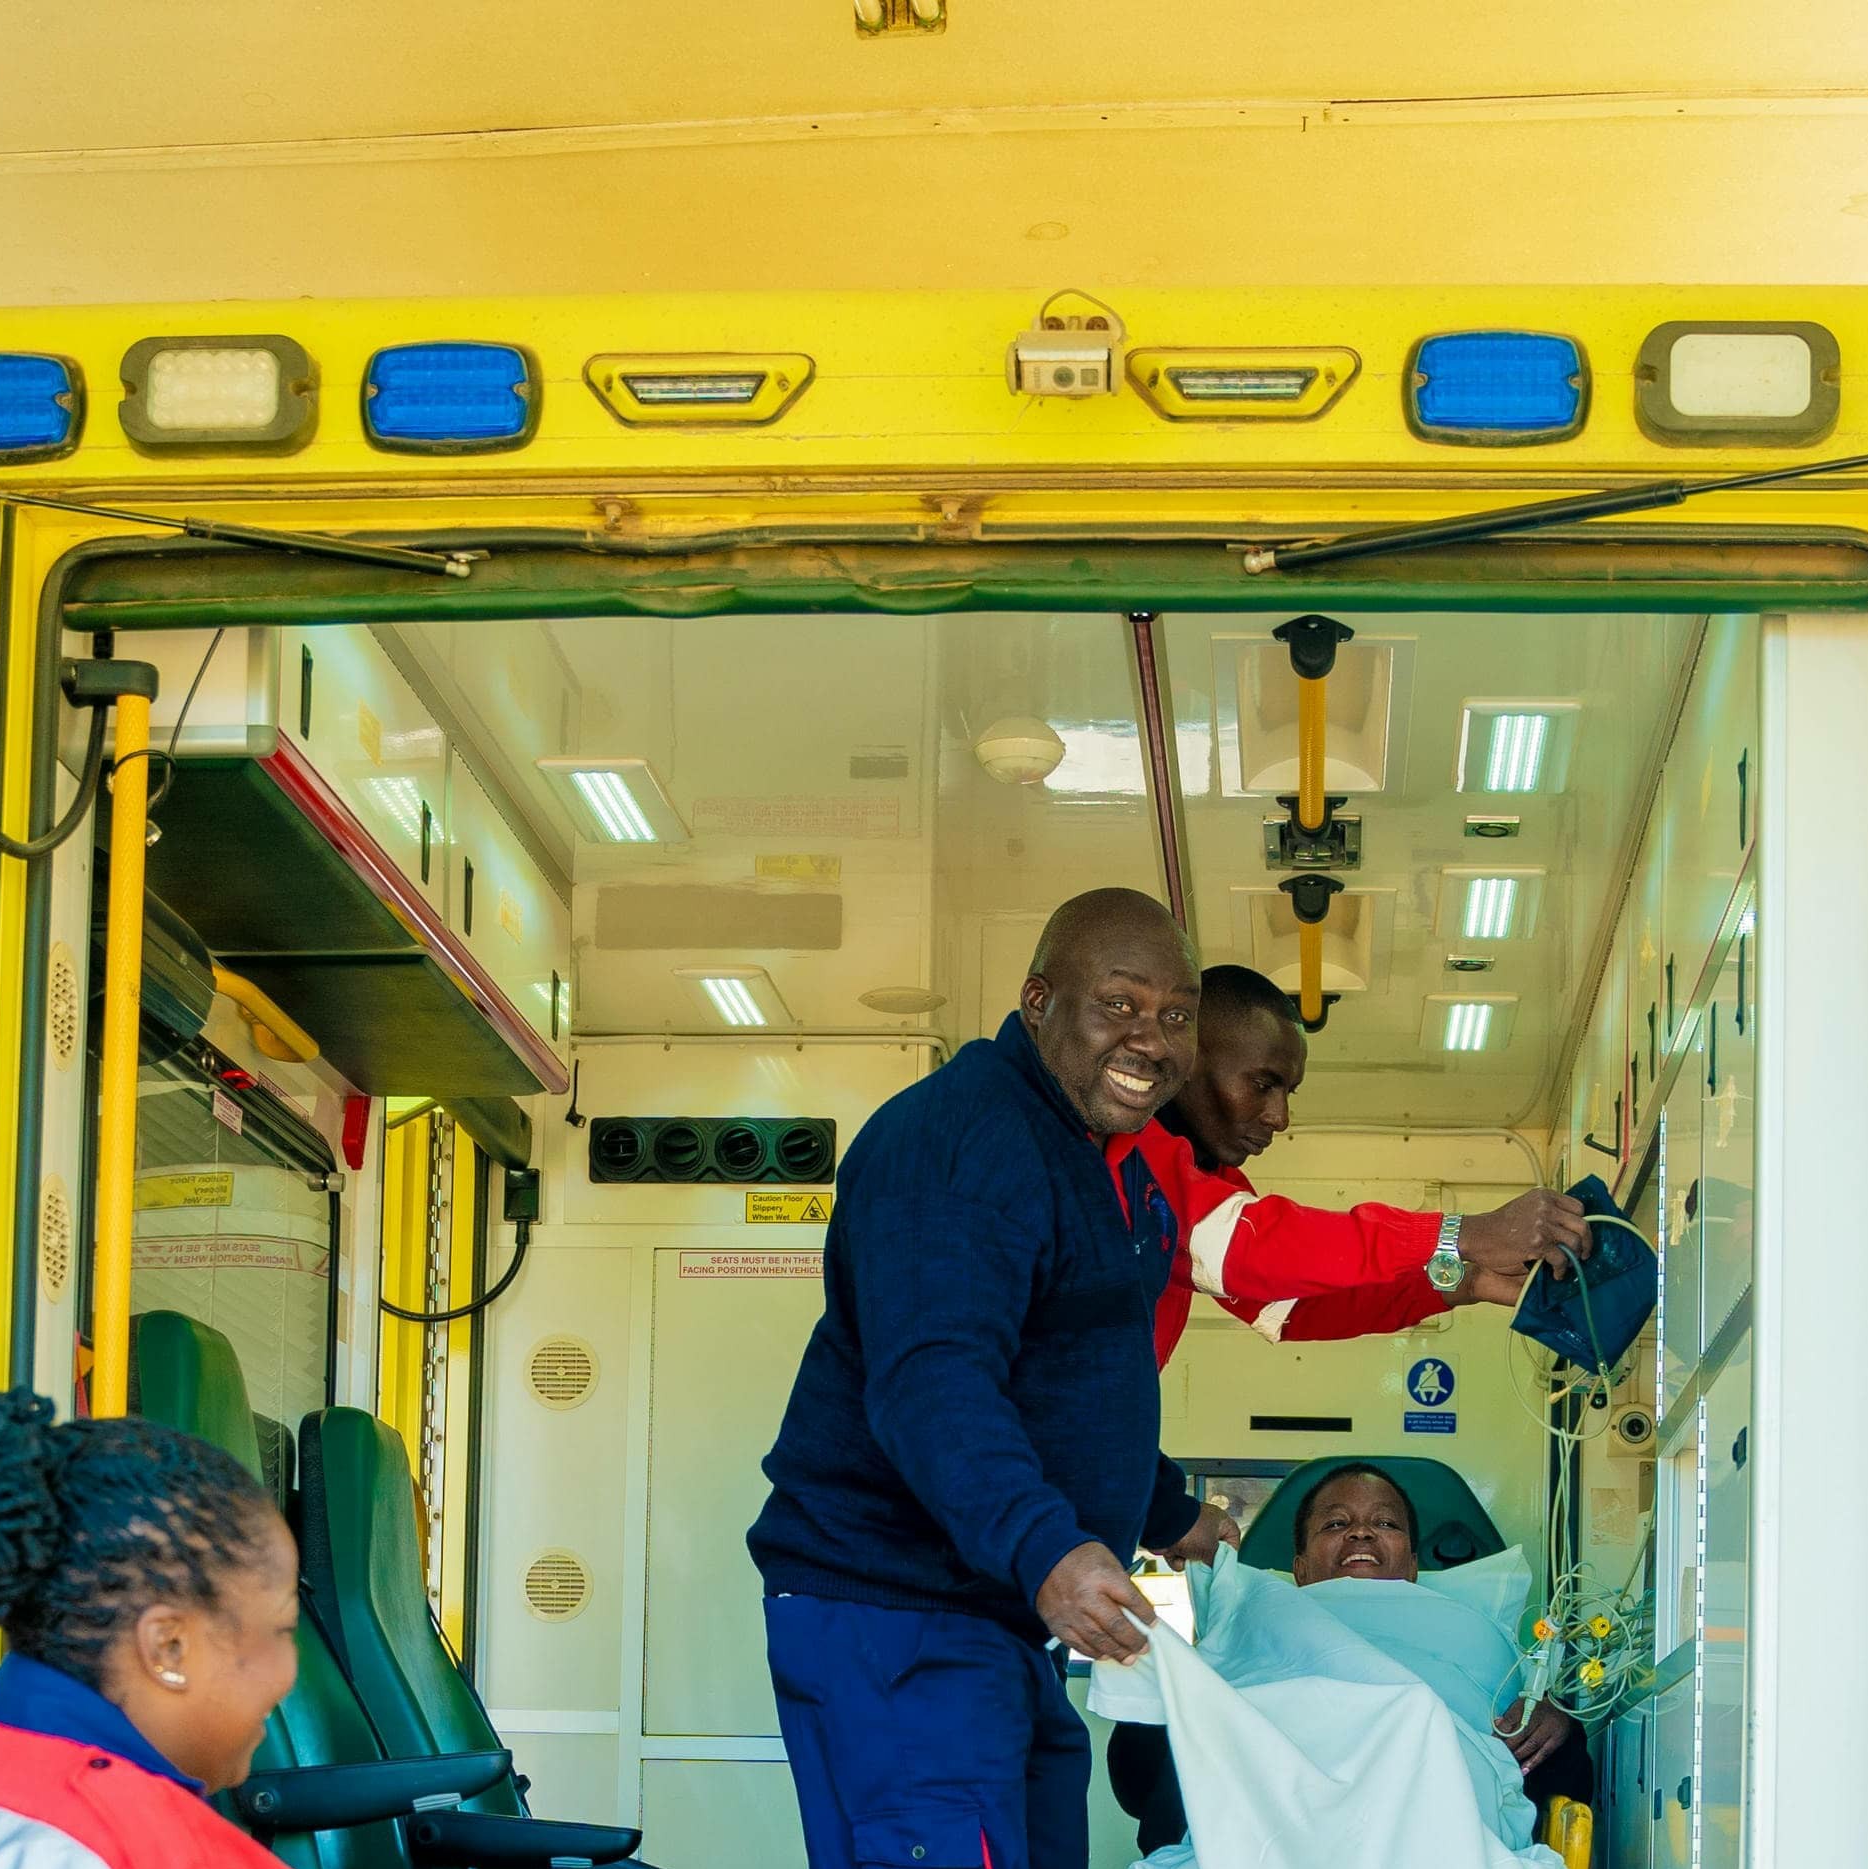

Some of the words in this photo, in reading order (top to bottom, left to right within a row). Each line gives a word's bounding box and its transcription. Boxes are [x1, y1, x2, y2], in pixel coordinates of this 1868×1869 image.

[752, 1194, 781, 1202] Caution
[783, 1194, 804, 1202] Floor
[752, 1204, 783, 1213] Slippery
[752, 1213, 774, 1221] When
[775, 1213, 790, 1221] Wet
[711, 1256, 740, 1264] SEATS
[741, 1256, 766, 1264] MUST
[768, 1256, 780, 1264] BE
[782, 1256, 792, 1264] IN
[794, 1256, 810, 1264] THE
[683, 1266, 715, 1274] FACING
[717, 1266, 760, 1274] POSITION
[761, 1266, 788, 1274] WHEN
